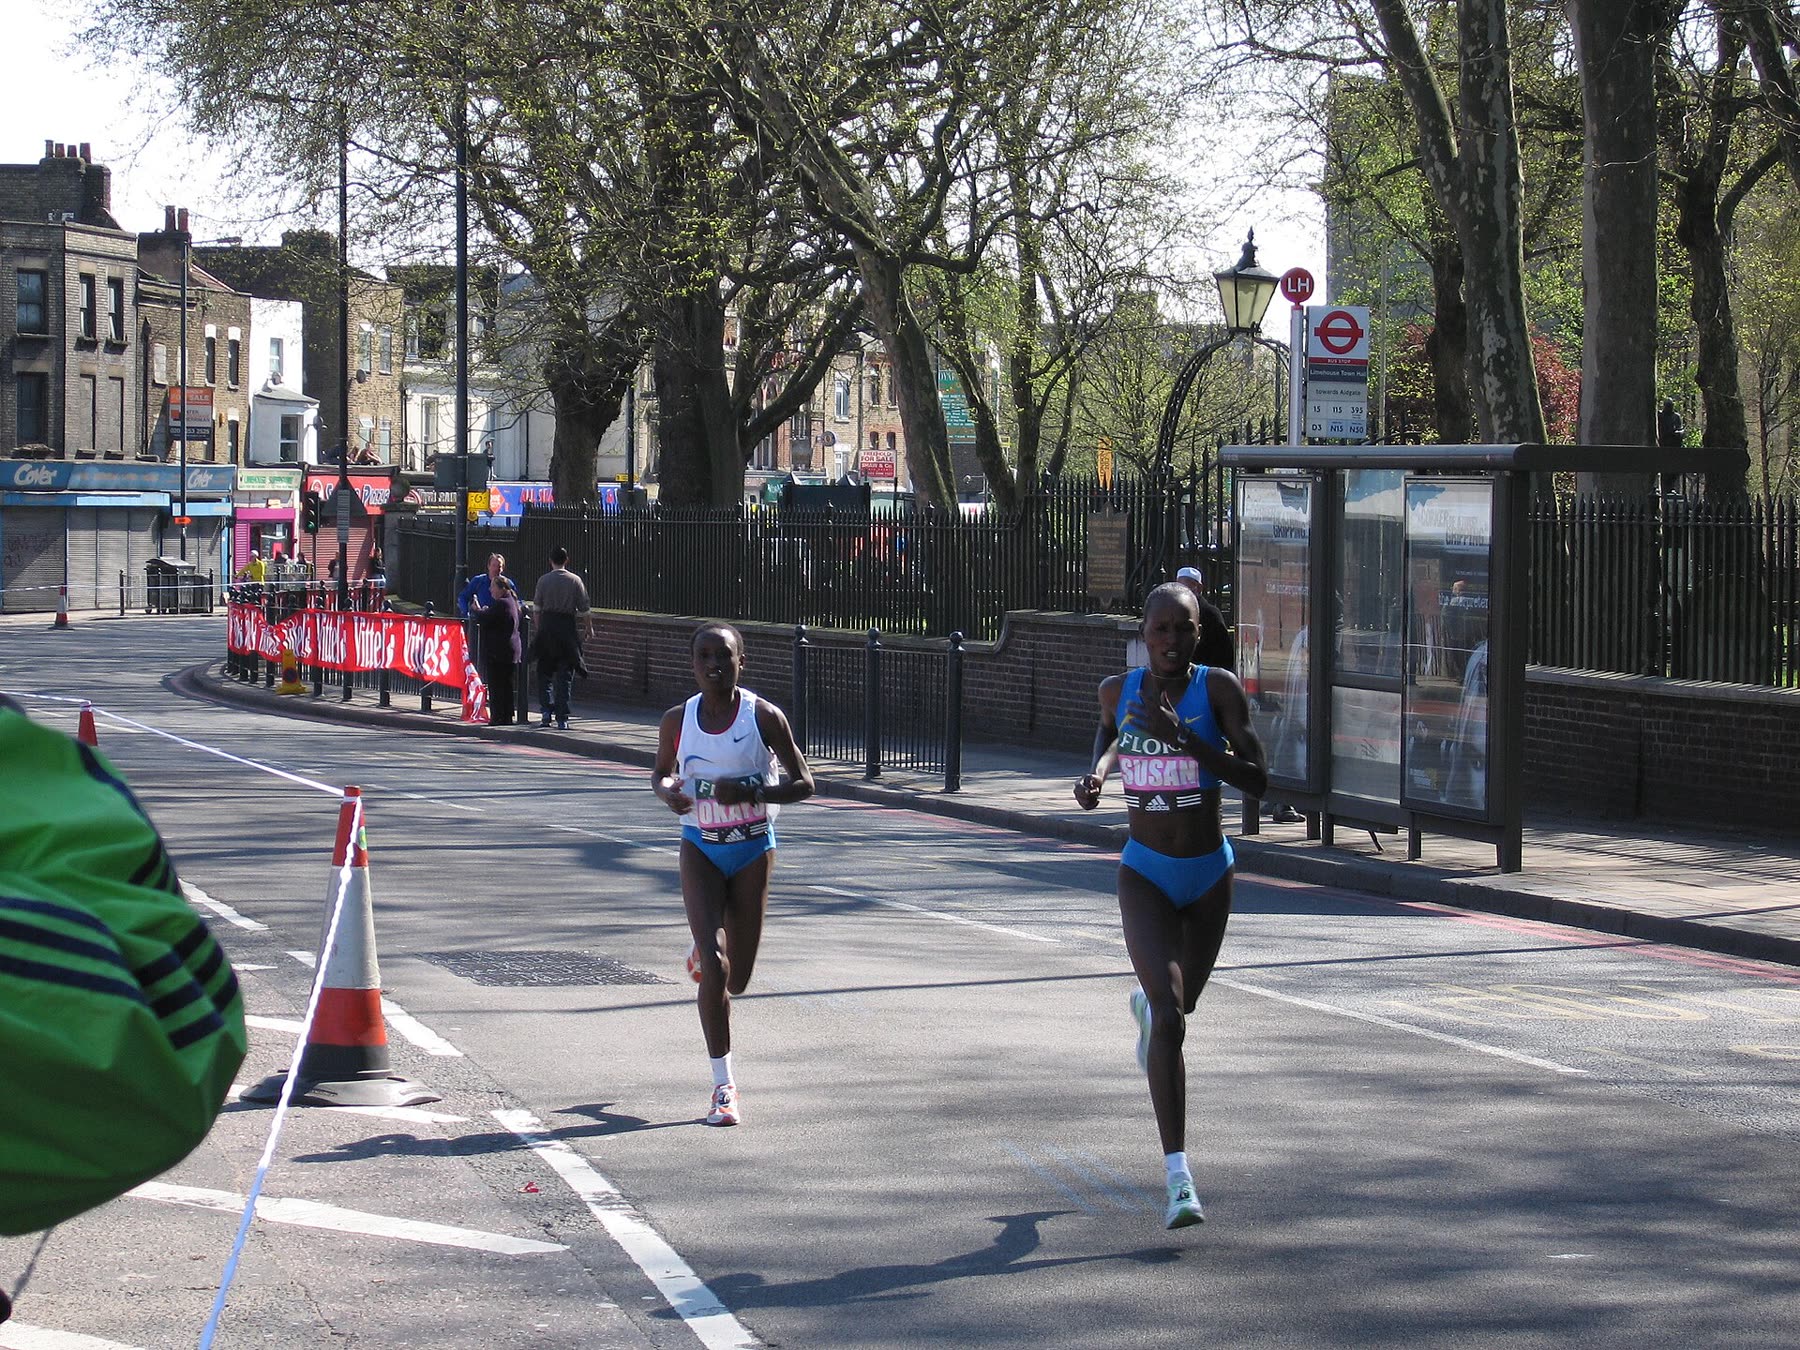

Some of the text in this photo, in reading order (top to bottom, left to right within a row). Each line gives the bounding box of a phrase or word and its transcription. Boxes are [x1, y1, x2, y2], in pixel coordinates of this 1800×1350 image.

[1287, 277, 1310, 293] LH
[1340, 389, 1362, 397] Aldgate
[1313, 405, 1364, 414] 15 115 395
[1311, 423, 1364, 434] D3 N15 N50
[353, 616, 388, 669] Vittel
[1120, 758, 1197, 788] SUSAN
[724, 834, 746, 843] adidas
